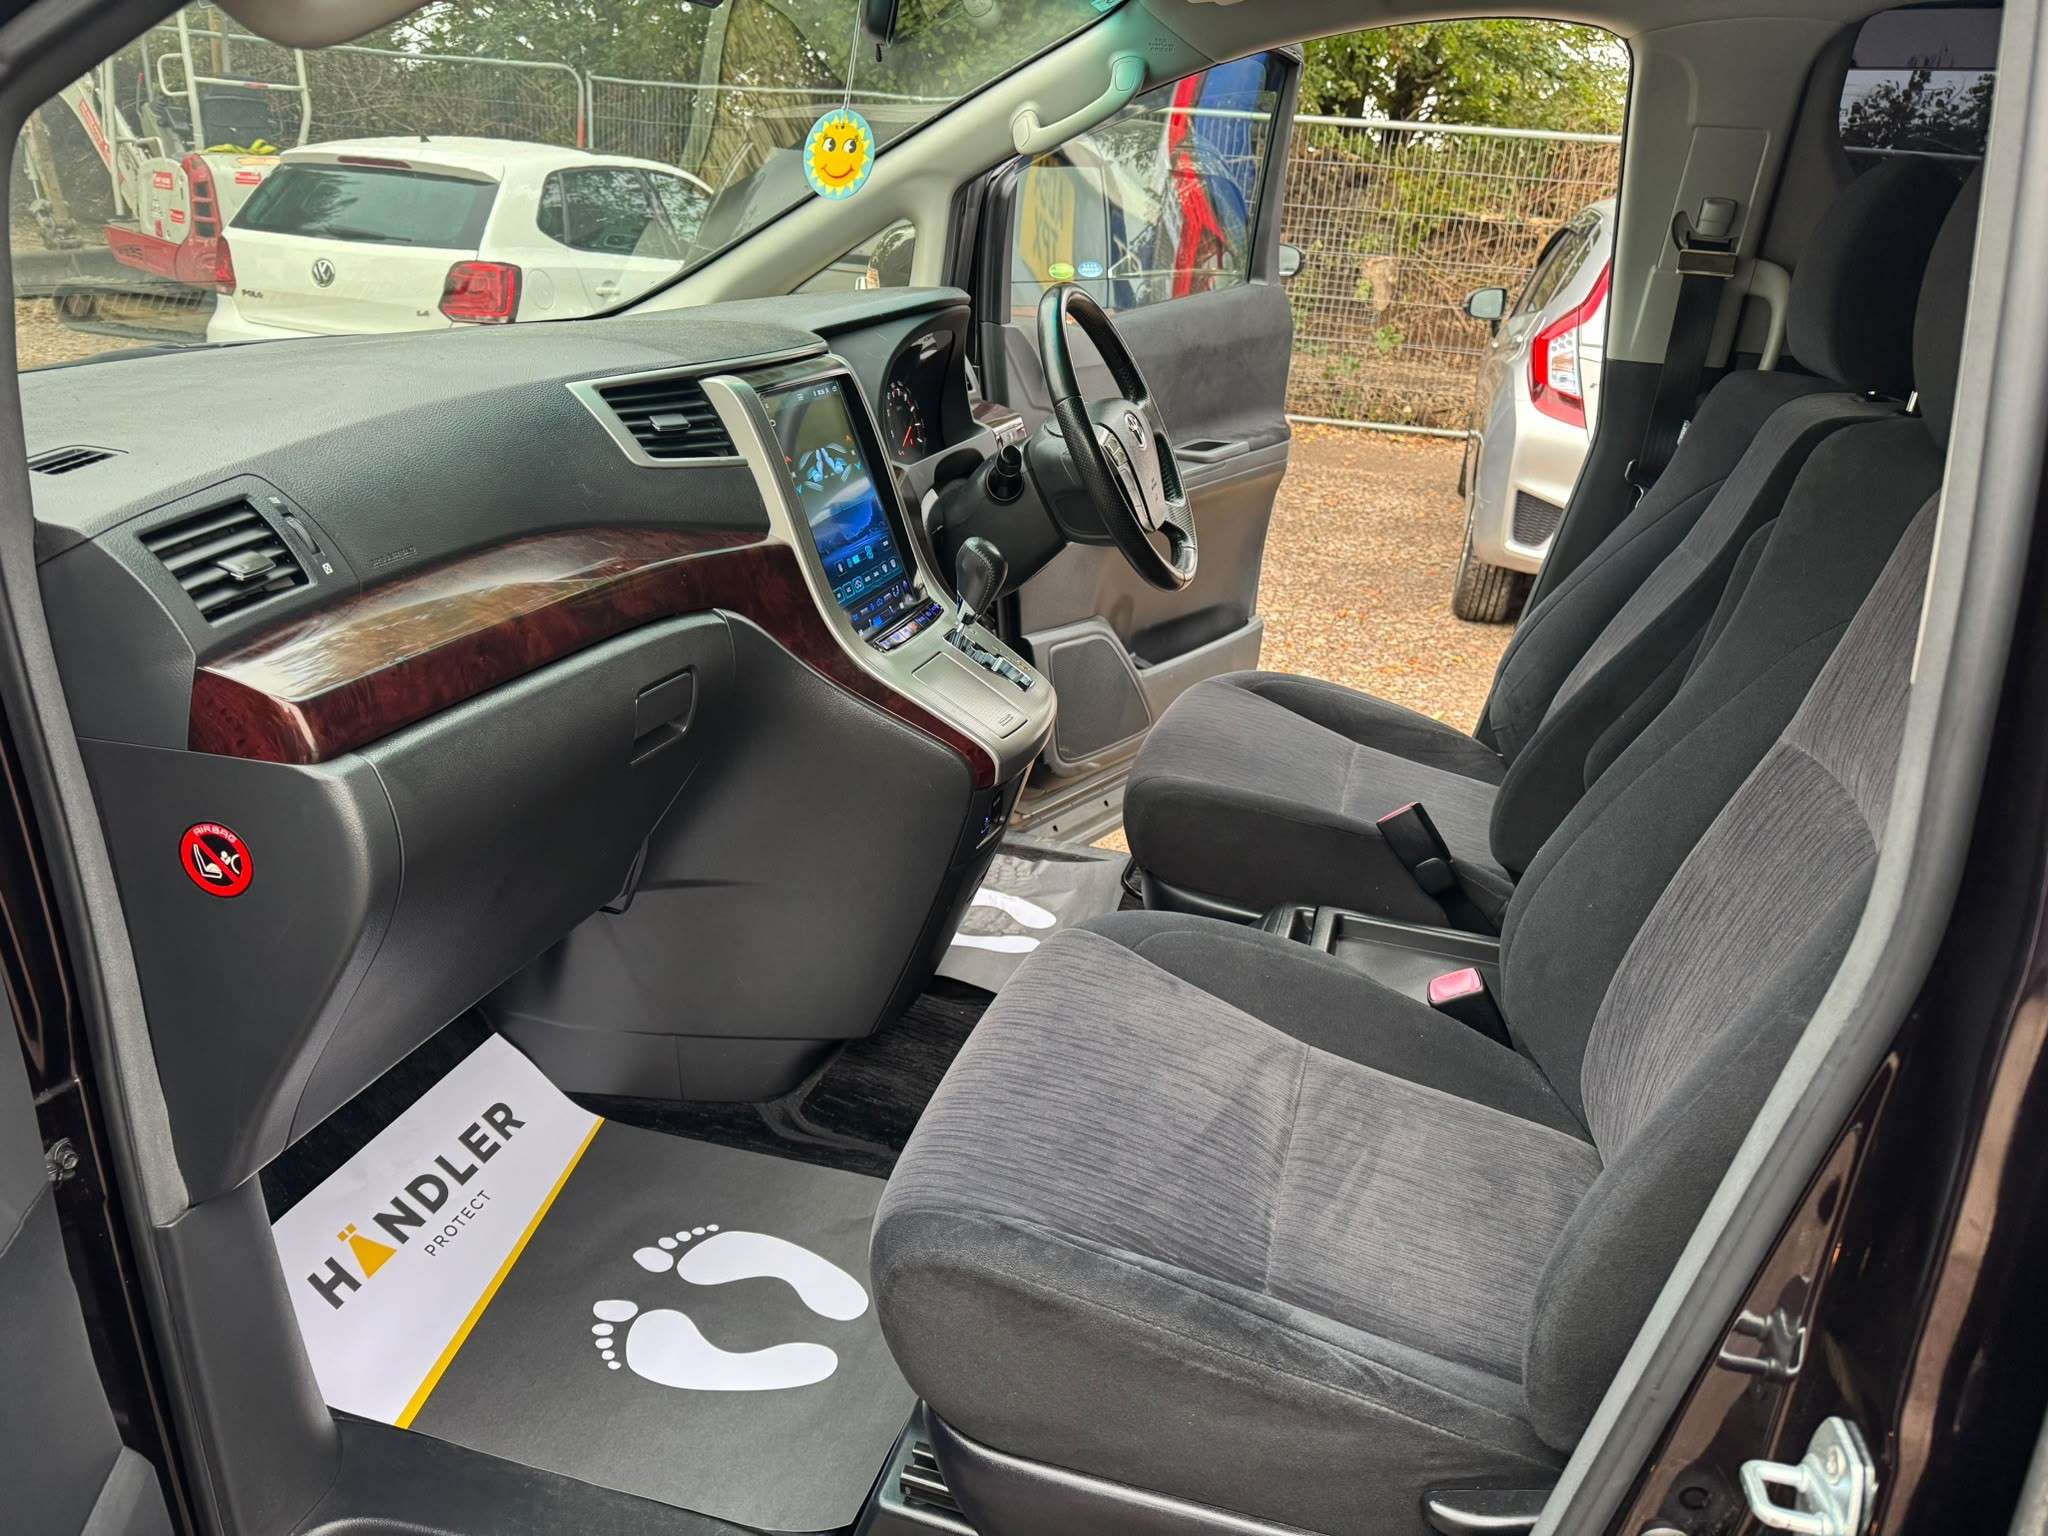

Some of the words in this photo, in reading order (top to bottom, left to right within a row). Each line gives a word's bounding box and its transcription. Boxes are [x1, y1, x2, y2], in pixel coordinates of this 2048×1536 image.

[193, 825, 239, 843] AIRBAG
[306, 1102, 526, 1310] HÄNDLER
[424, 1190, 491, 1257] PROTECT
